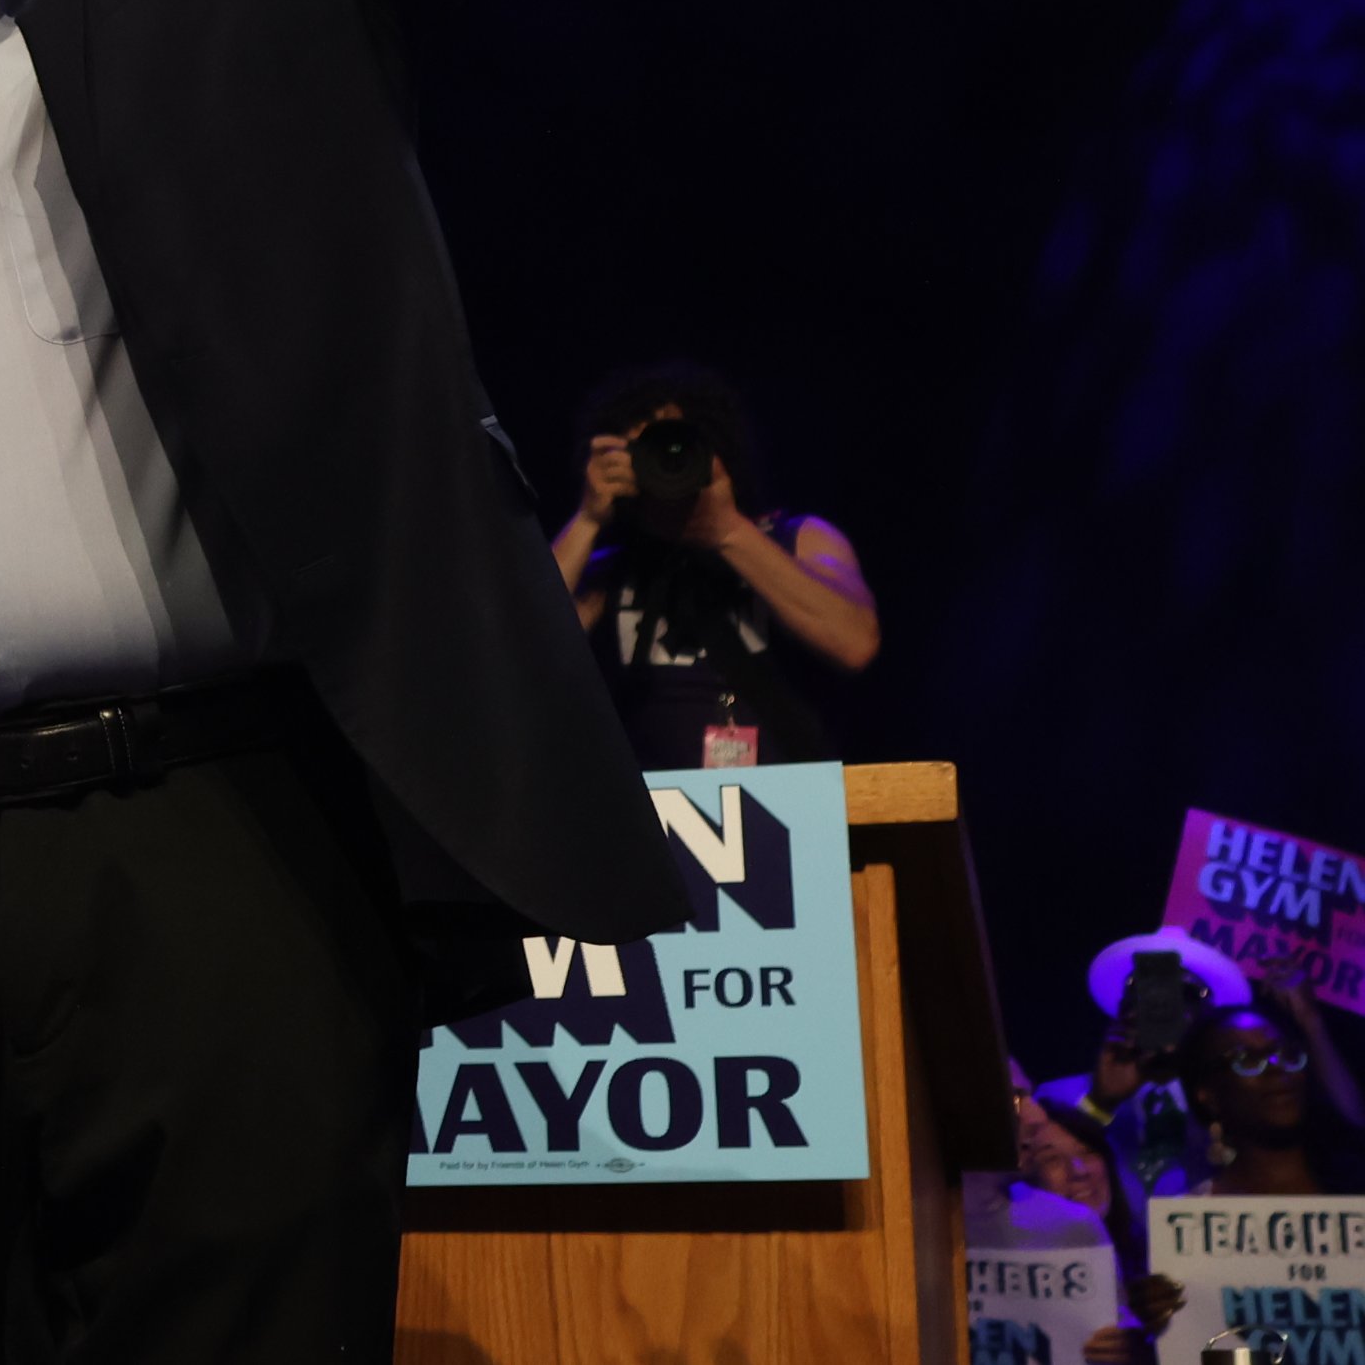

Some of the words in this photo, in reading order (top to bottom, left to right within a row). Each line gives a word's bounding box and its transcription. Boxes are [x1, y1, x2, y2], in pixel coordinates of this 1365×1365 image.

[1197, 860, 1320, 928] GYM
[683, 966, 796, 1009] FOR
[409, 1055, 809, 1154] AYOR
[1289, 1264, 1327, 1282] FOR
